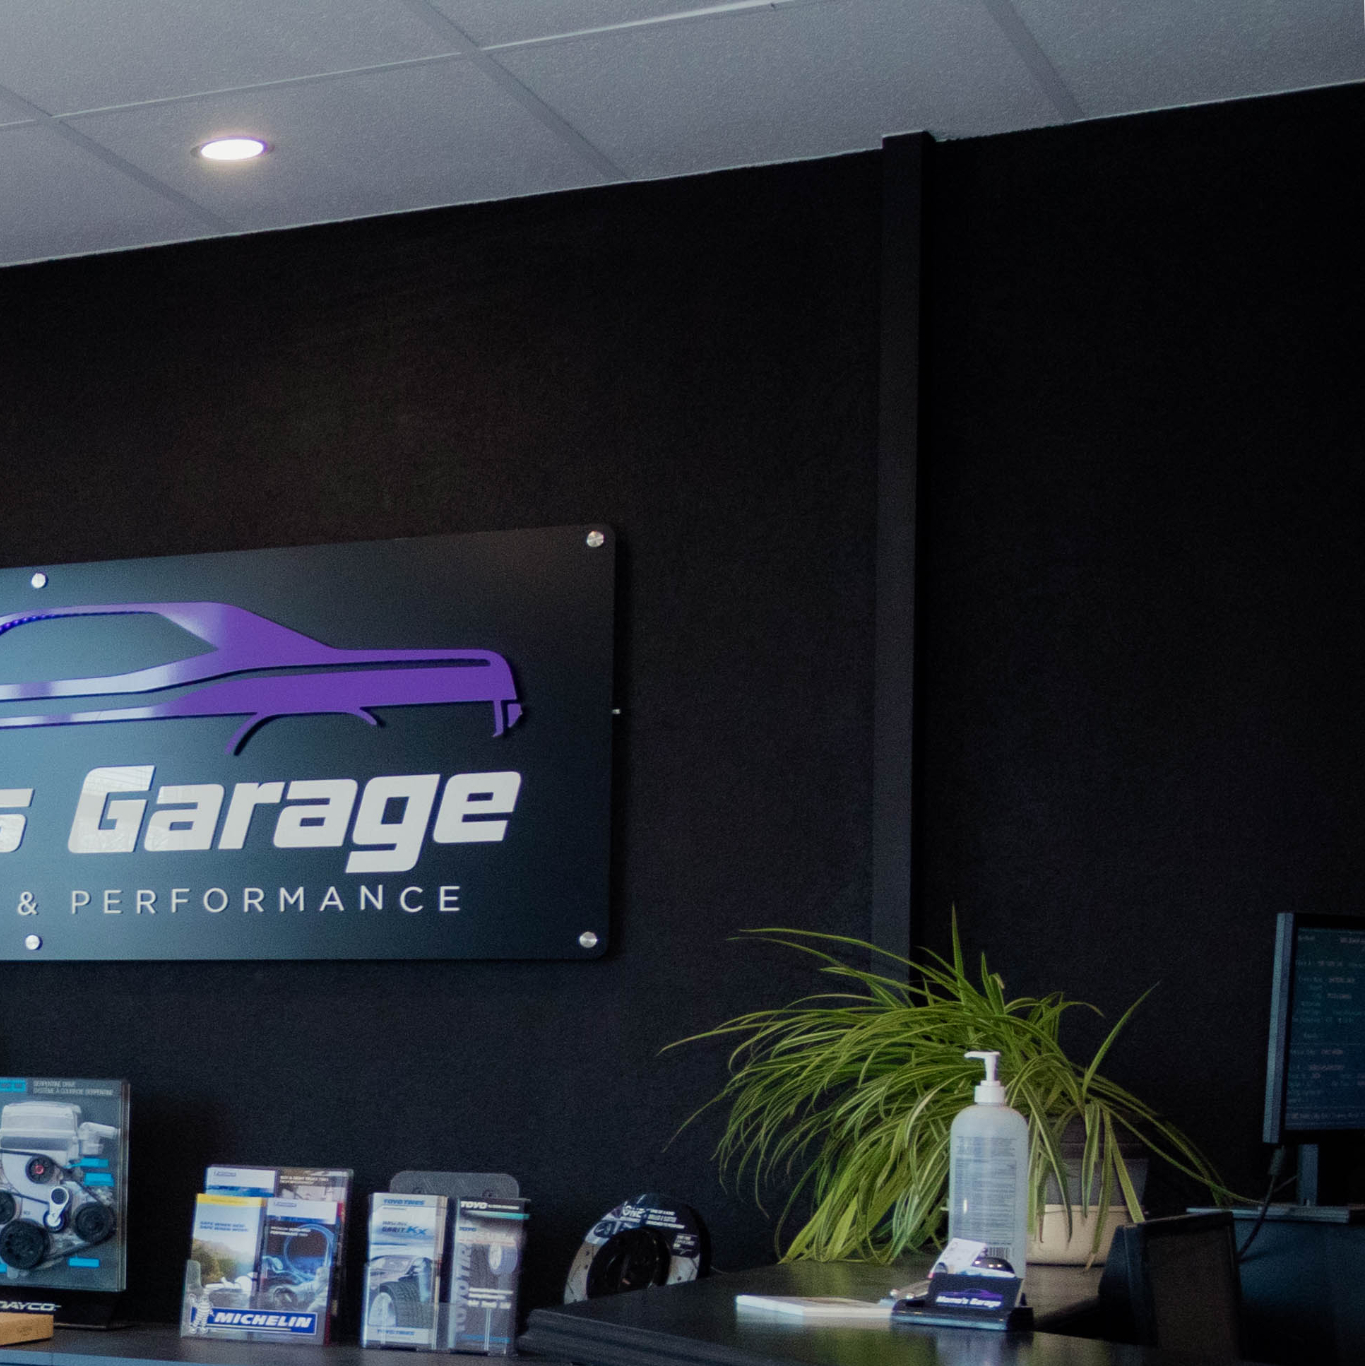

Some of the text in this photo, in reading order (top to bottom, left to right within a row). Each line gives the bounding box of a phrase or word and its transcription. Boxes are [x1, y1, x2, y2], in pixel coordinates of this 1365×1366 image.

[66, 765, 522, 874] Garage
[16, 891, 41, 917] &
[70, 885, 464, 916] PERFORMANCE
[460, 1200, 488, 1210] TOYO
[213, 1311, 314, 1329] MICHELIN
